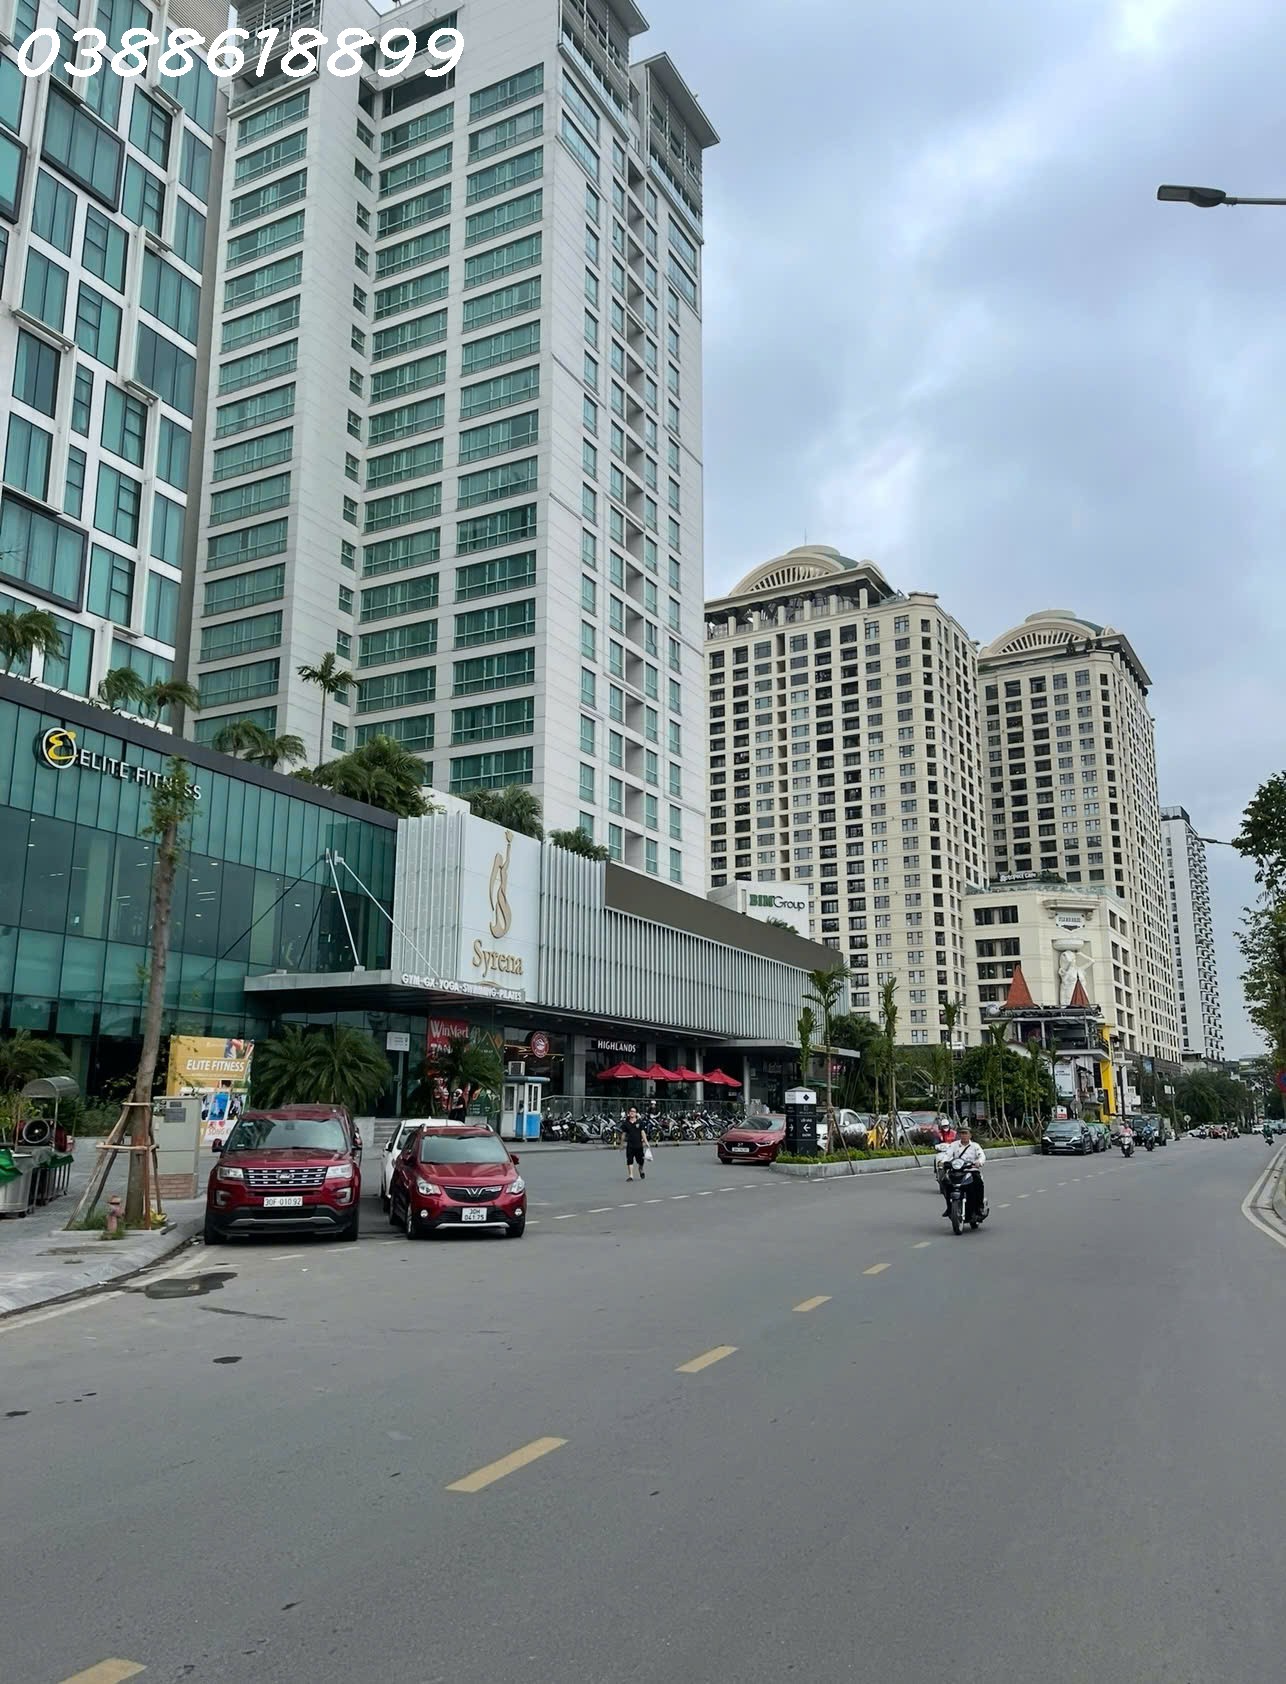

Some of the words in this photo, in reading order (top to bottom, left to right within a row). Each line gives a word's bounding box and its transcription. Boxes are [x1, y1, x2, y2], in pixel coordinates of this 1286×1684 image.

[80, 748, 130, 780] ELITE
[136, 766, 201, 800] FITNSS
[472, 939, 524, 978] Syrena
[597, 1040, 636, 1053] HIGHLANDS
[186, 1060, 211, 1071] ELITE
[211, 1060, 245, 1072] FITNESS
